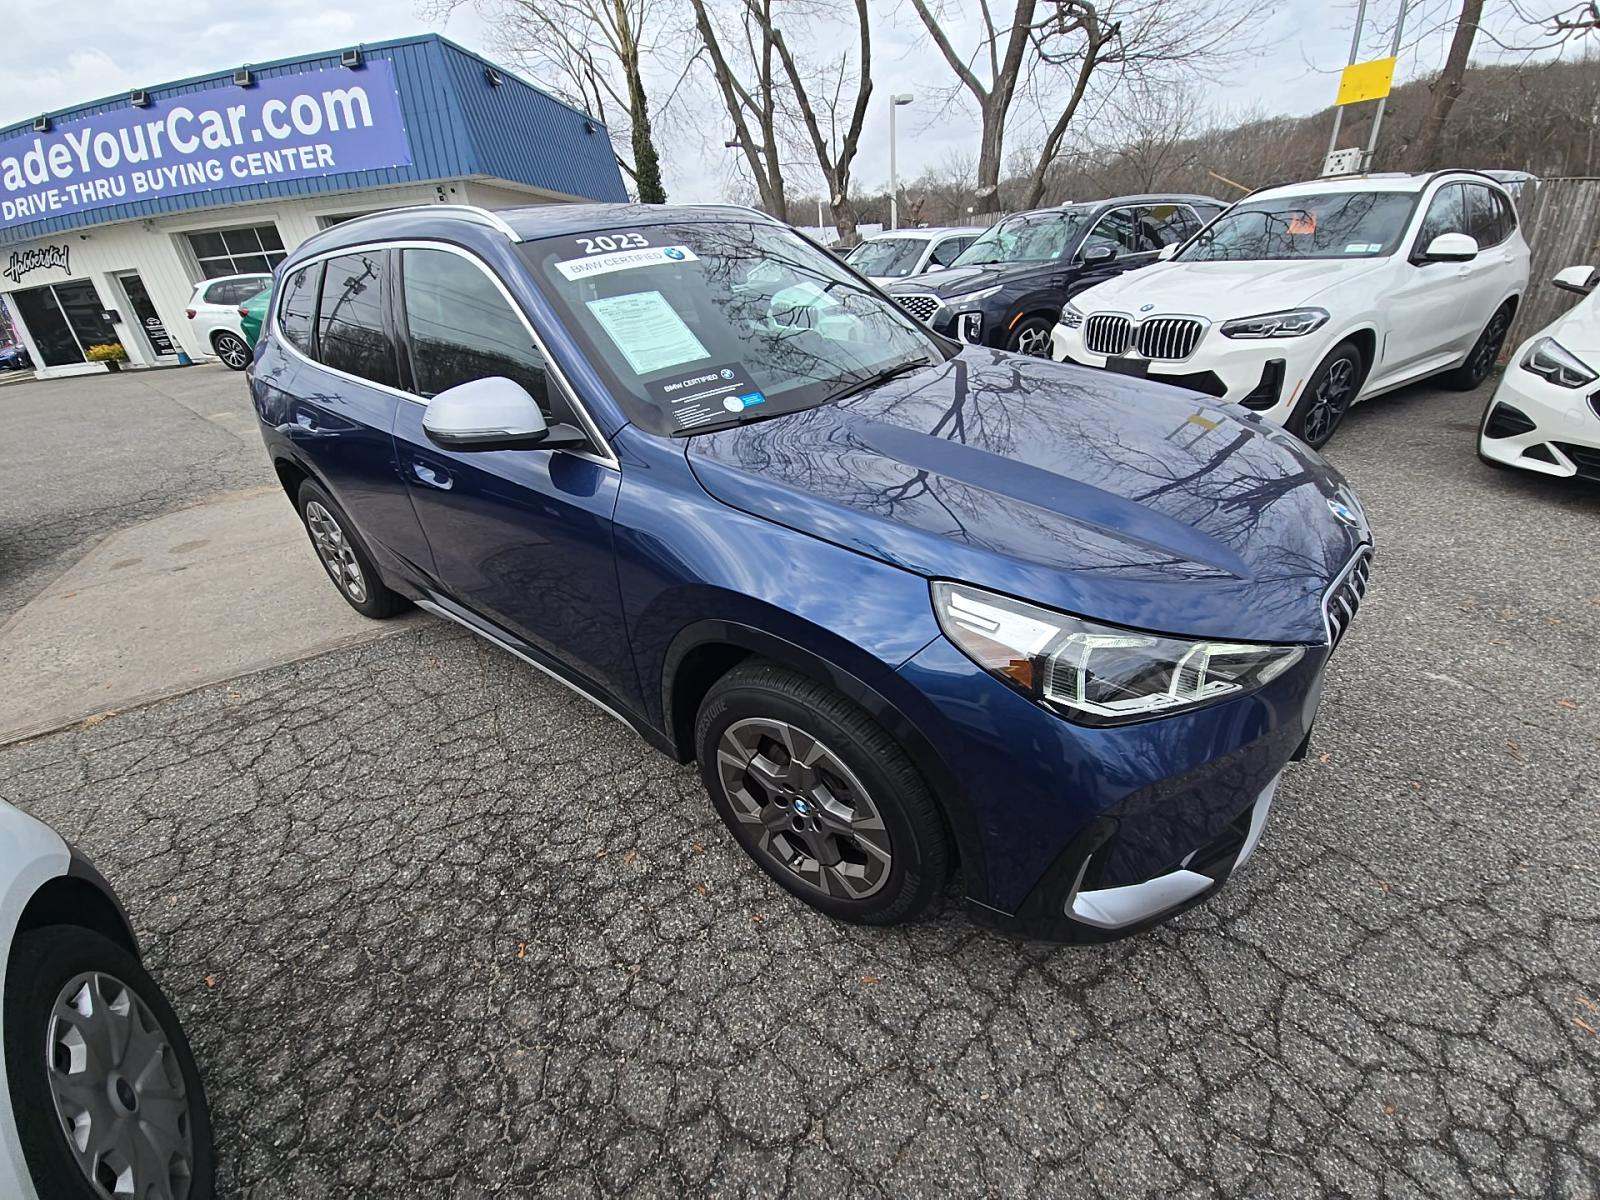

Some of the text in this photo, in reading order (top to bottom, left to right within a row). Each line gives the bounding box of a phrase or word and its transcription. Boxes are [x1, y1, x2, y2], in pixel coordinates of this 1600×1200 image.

[1, 86, 373, 191] adeYourCar.com
[2, 143, 336, 221] DRIVE-THRU BUYING CENTER
[576, 233, 650, 254] 2023
[3, 244, 72, 284] Habberstad
[570, 251, 663, 274] BMW CERTIFIED
[664, 381, 684, 393] BMW
[683, 373, 719, 389] CERTIFIED
